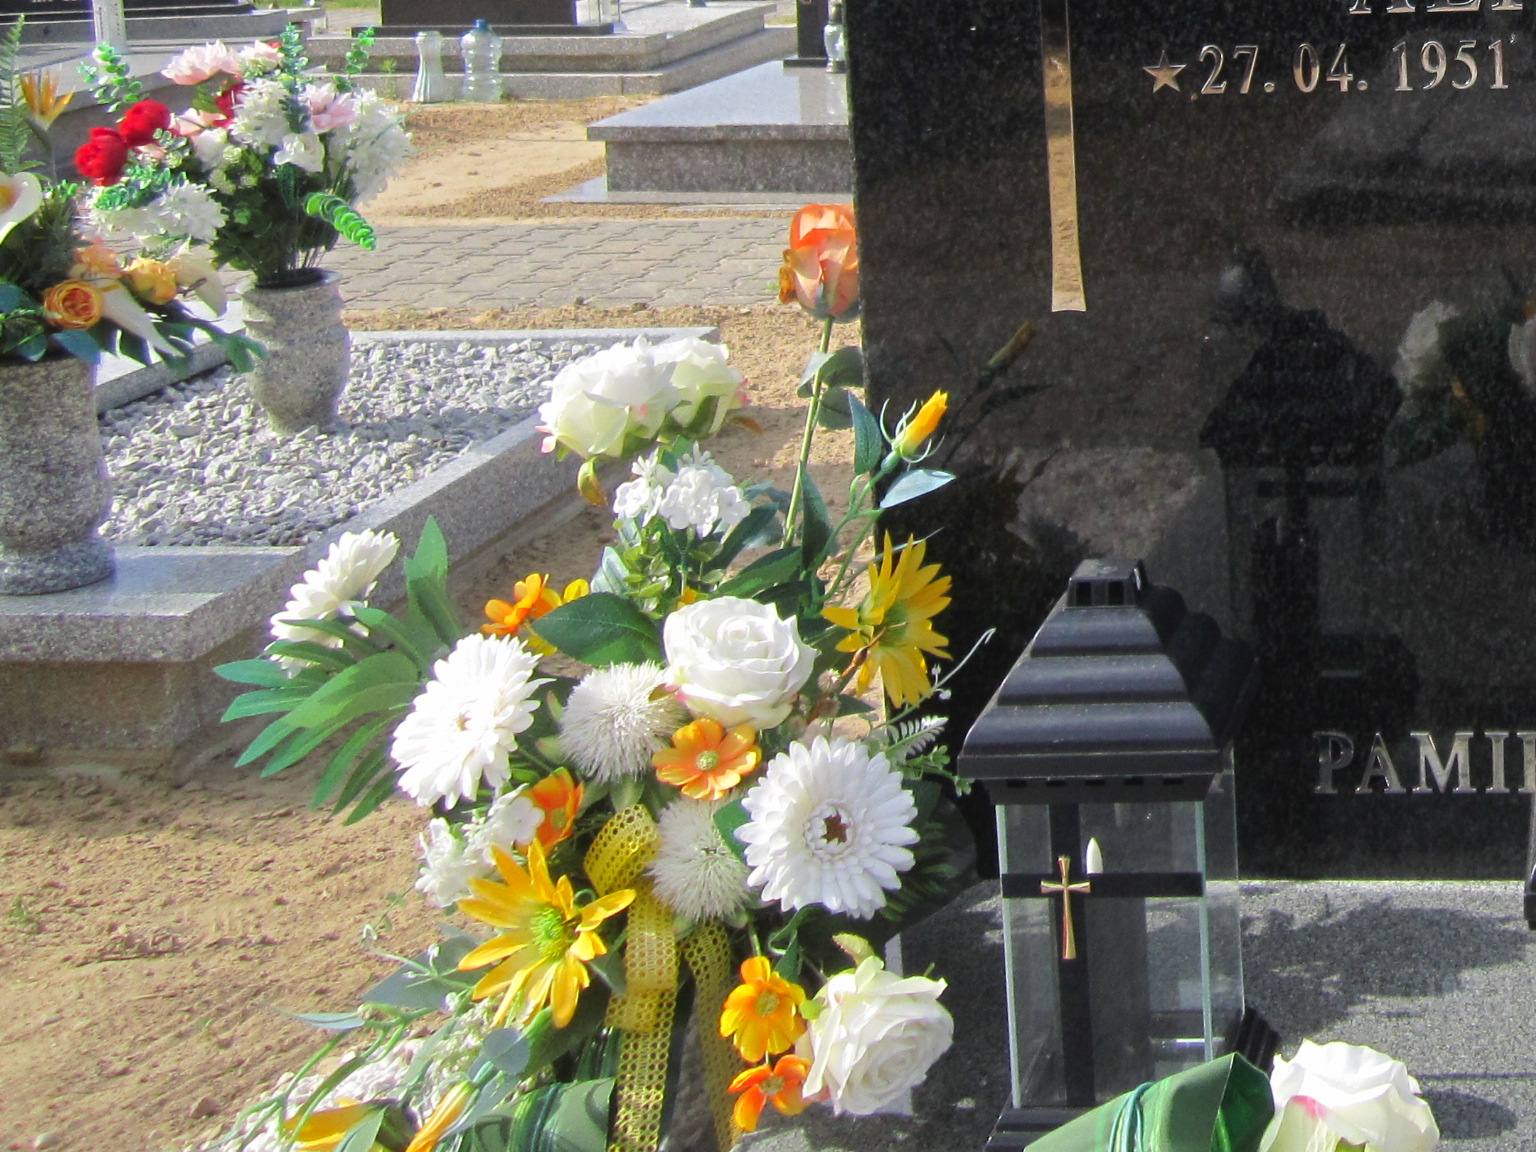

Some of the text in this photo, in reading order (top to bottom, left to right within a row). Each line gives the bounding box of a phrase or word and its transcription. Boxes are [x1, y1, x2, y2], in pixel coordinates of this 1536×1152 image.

[1199, 44, 1276, 95] 27.
[1292, 42, 1368, 93] 04.
[1392, 39, 1510, 91] 1951
